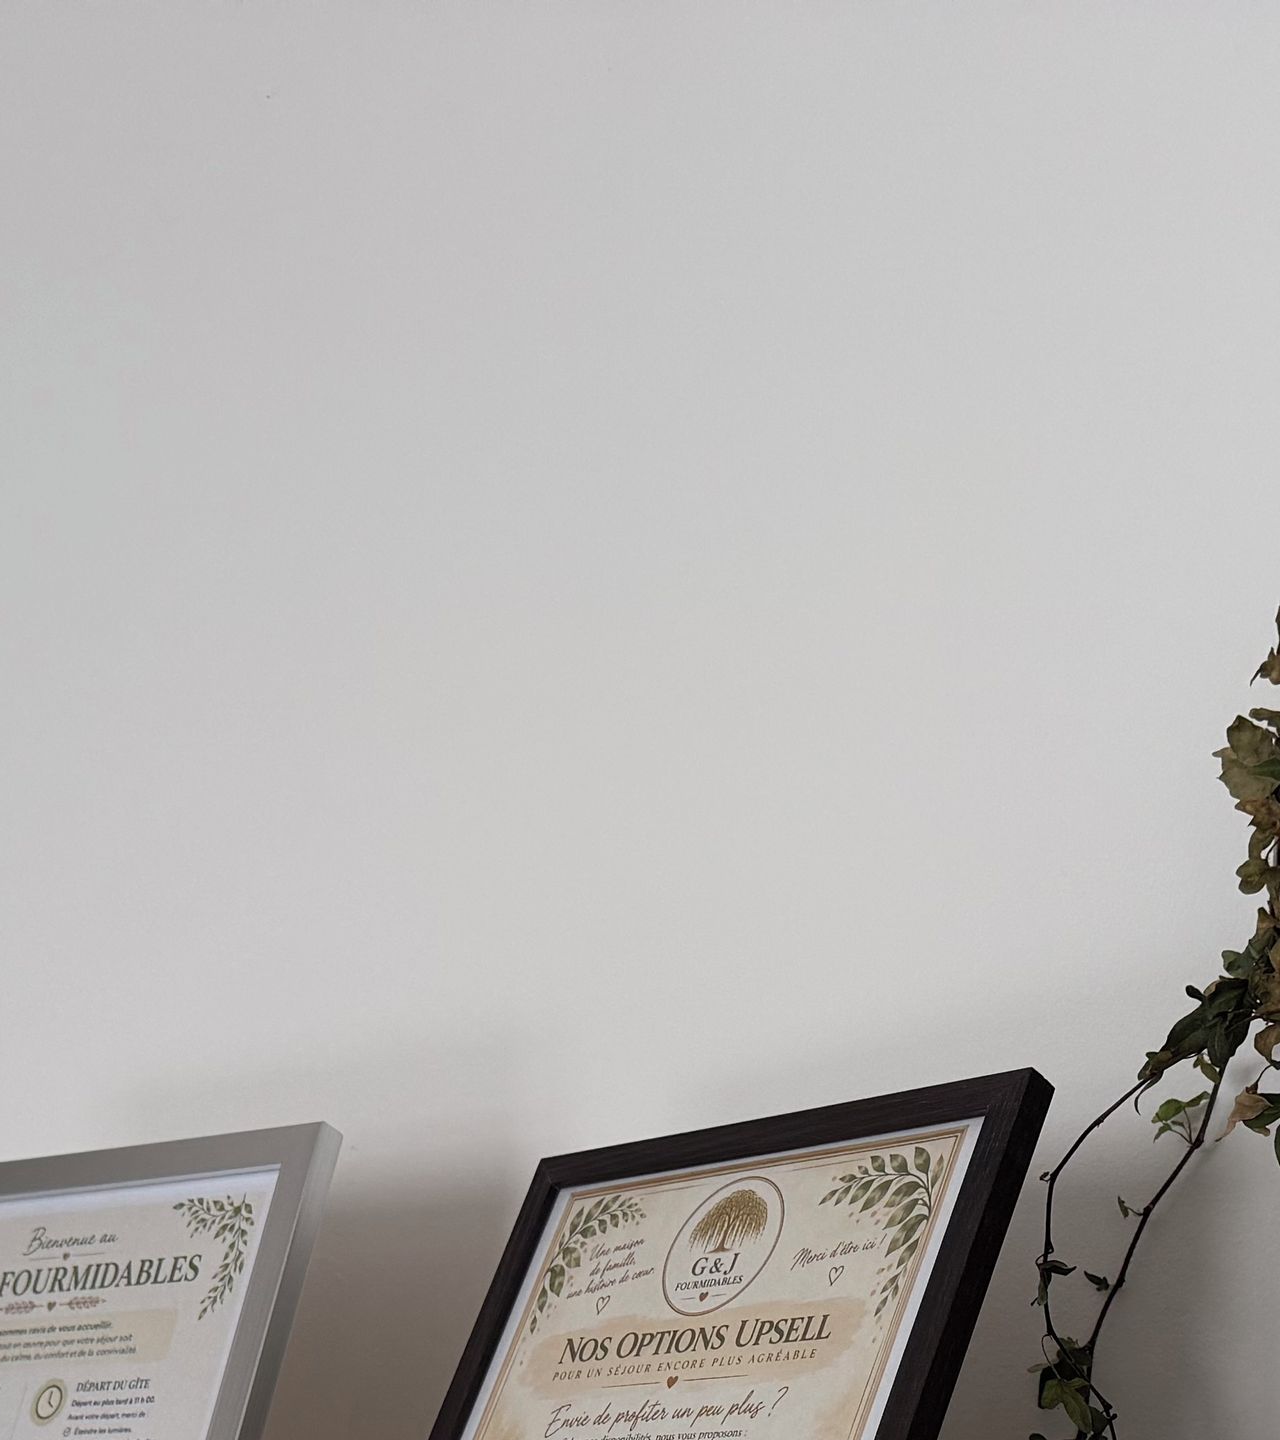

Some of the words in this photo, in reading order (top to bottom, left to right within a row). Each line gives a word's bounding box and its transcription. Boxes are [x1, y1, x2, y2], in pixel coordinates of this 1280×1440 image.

[22, 1226, 96, 1256] Bienvenue
[99, 1233, 117, 1244] au
[589, 1242, 611, 1262] Une
[612, 1238, 645, 1253] maison
[790, 1247, 827, 1271] Merci
[829, 1241, 860, 1258] d'être
[861, 1241, 877, 1251] ici
[879, 1233, 888, 1245] !
[674, 1275, 744, 1292] FOURMIDABLES
[552, 1369, 583, 1382] POUR
[586, 1368, 601, 1379] UN
[606, 1363, 652, 1377] SÉJOUR
[656, 1358, 706, 1372] ENCORE
[711, 1355, 743, 1367] PLUS
[747, 1348, 817, 1364] AGRÉABLE
[76, 1380, 113, 1393] DÉPART
[112, 1380, 128, 1391] DU
[128, 1377, 151, 1390] GÎTE
[544, 1403, 591, 1439] Envie
[592, 1402, 612, 1426] de
[607, 1399, 669, 1433] profiter
[671, 1407, 694, 1420] un
[689, 1405, 725, 1428] peu
[720, 1389, 765, 1425] plus
[767, 1386, 790, 1417] ?
[677, 1432, 697, 1440] vous
